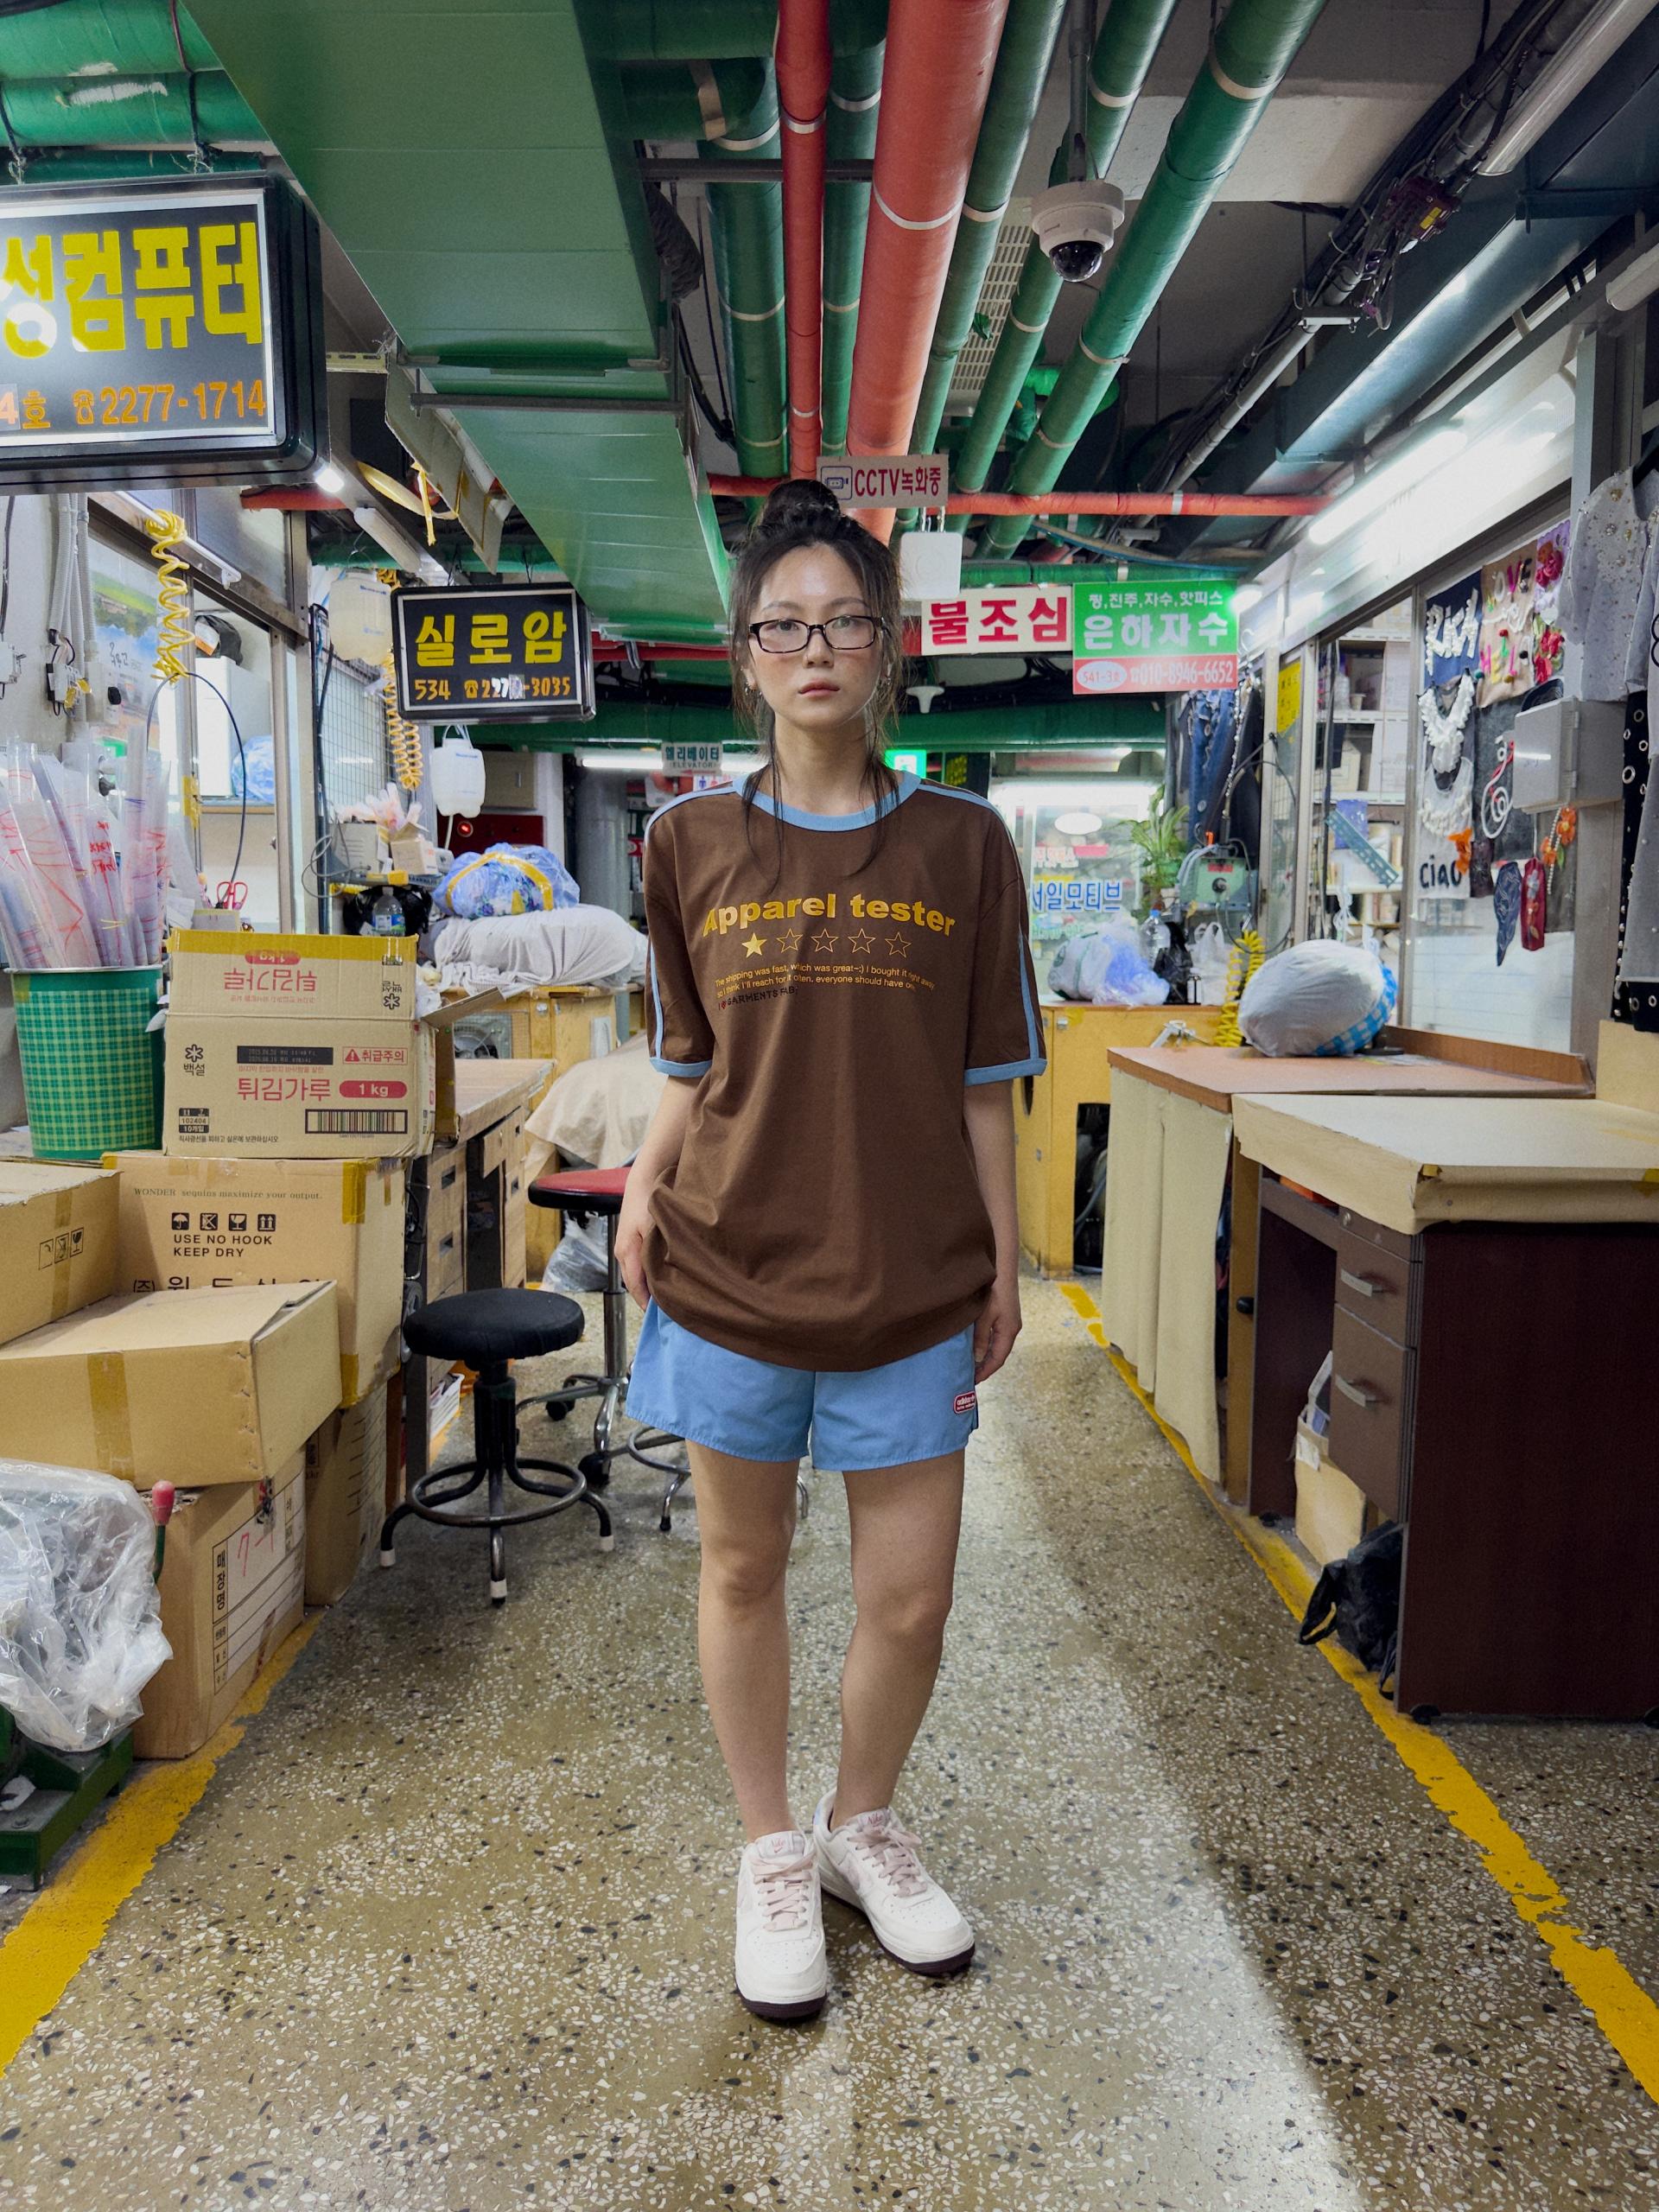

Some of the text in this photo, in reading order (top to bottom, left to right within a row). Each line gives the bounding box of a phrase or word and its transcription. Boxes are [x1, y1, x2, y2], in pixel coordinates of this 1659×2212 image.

[2, 221, 263, 359] 성컴퓨터
[99, 379, 267, 425] 2277-1714
[927, 596, 1068, 646] 불조심
[415, 610, 568, 667] 실로암
[1084, 612, 1229, 650] 은하자수
[414, 678, 451, 701] 534
[664, 746, 720, 761] 엘리베이터
[702, 893, 956, 938] Apparel tester
[753, 967, 771, 976] was
[871, 966, 900, 977] bought
[901, 969, 907, 977] it
[752, 978, 774, 988] reach
[815, 976, 854, 985] everyone
[855, 976, 882, 986] should
[883, 978, 904, 988] have
[727, 988, 779, 1006] GARMENTS
[360, 1049, 406, 1064] 취급주의
[183, 1062, 206, 1077] 백설
[238, 1077, 332, 1103] 튀김가루
[358, 1082, 389, 1096] 1 kg
[134, 1187, 176, 1197] WONDER
[181, 1188, 217, 1198] sequins
[219, 1189, 264, 1198] maximize
[266, 1190, 287, 1199] your
[174, 1234, 273, 1245] USE NO HOOK
[174, 1247, 245, 1258] KEEP DRY
